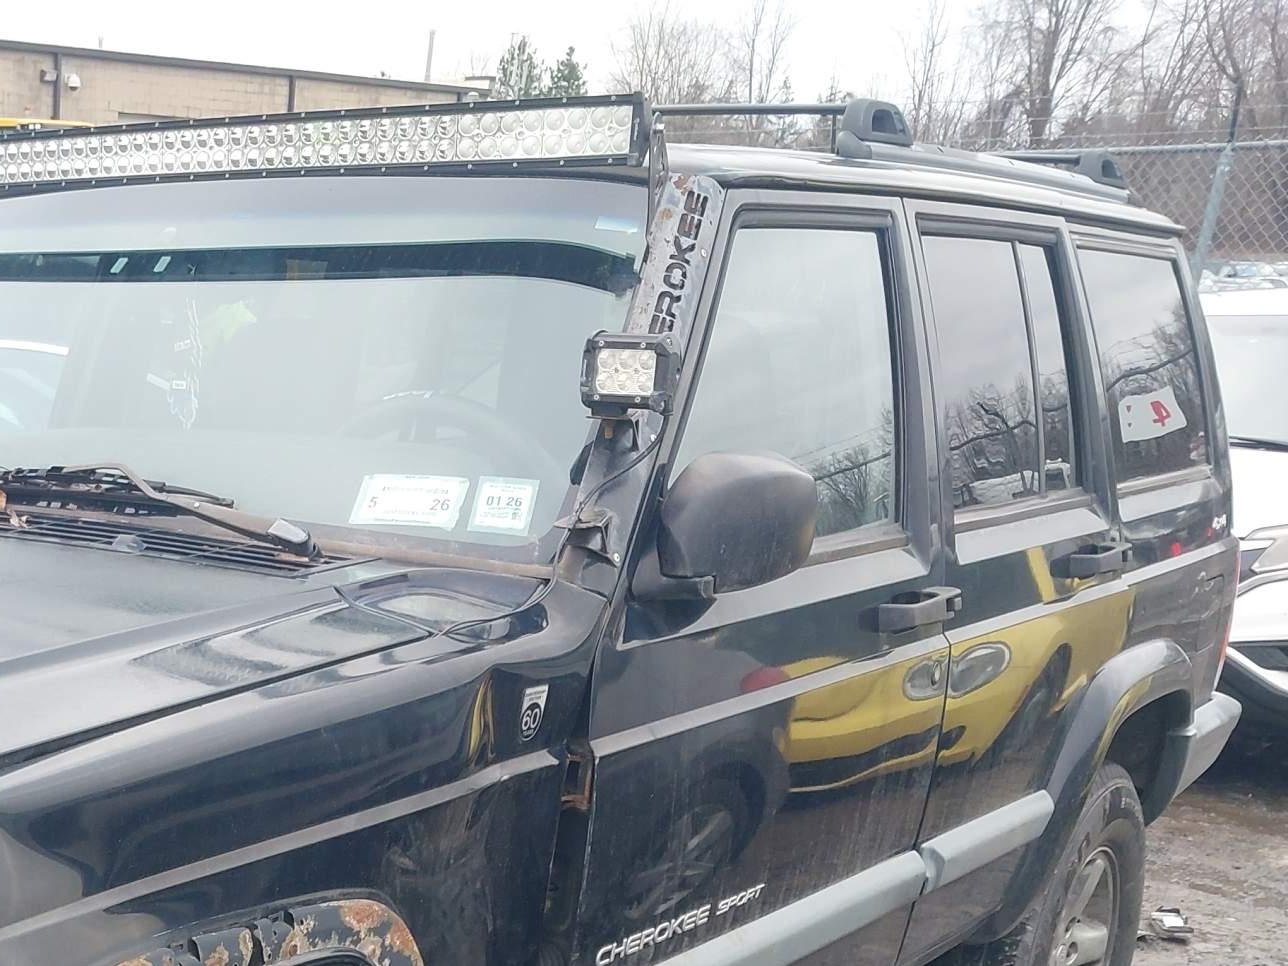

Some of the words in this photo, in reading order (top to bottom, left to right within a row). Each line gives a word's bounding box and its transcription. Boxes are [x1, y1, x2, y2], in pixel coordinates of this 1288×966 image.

[429, 499, 452, 511] 26
[486, 495, 501, 507] 01
[505, 496, 523, 508] 26
[522, 708, 540, 731] 60
[716, 883, 766, 916] SPORT
